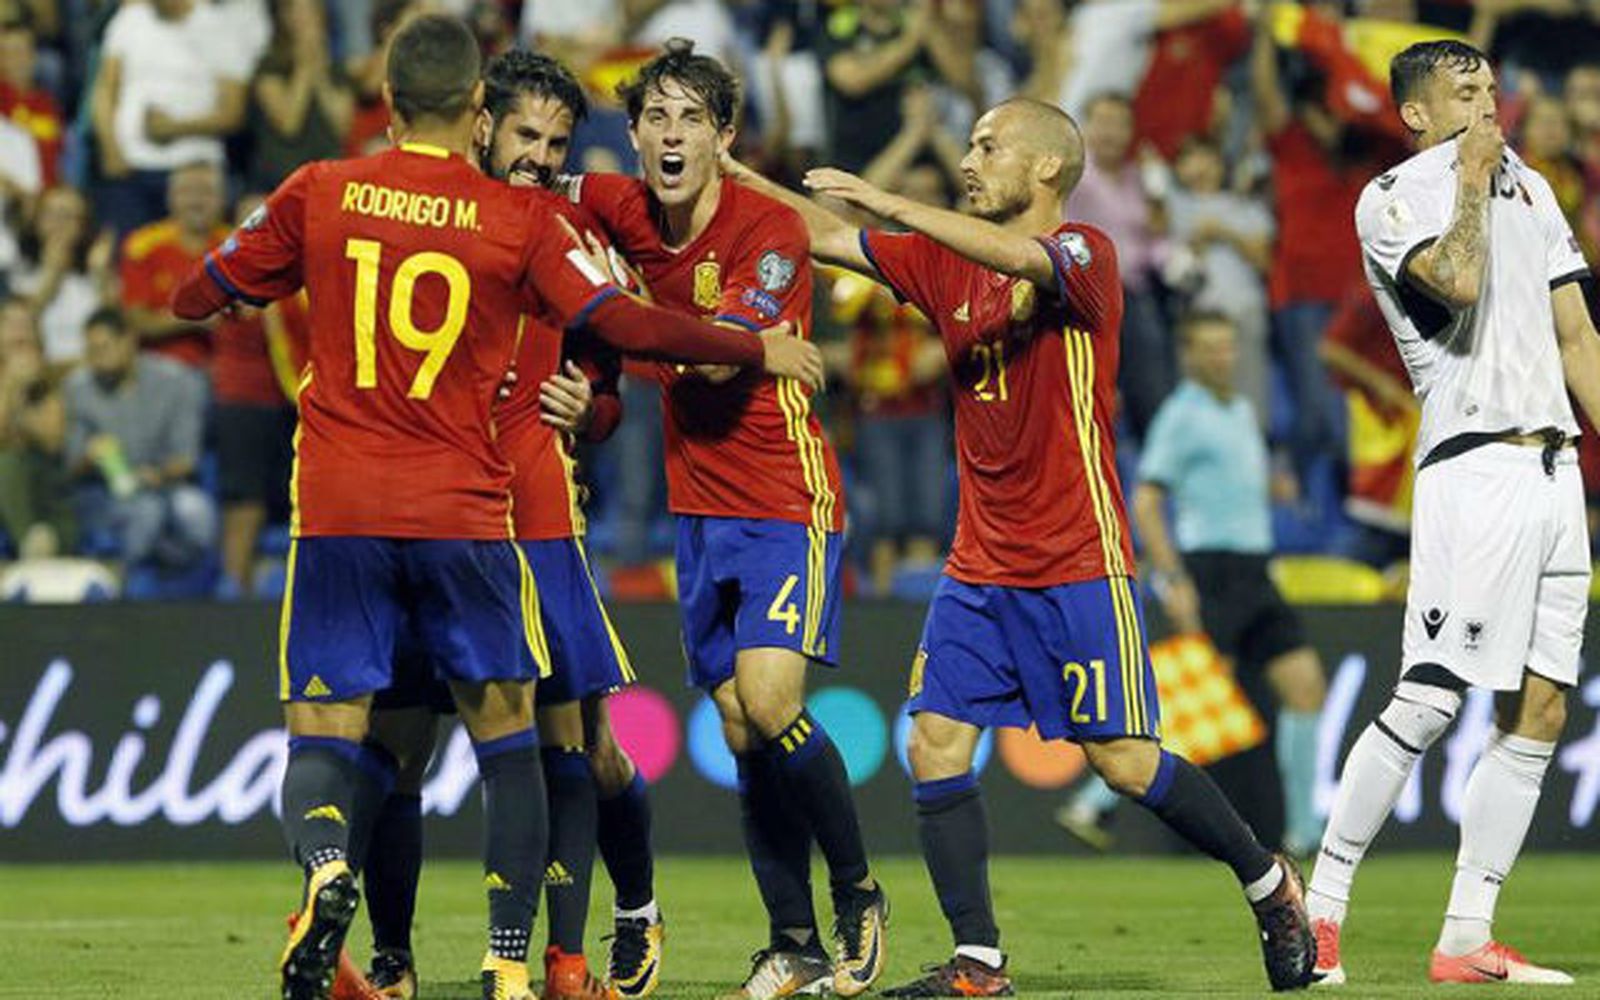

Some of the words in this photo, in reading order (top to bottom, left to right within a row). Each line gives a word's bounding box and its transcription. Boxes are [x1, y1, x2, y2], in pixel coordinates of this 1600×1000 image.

[341, 181, 451, 228] RODRIGO
[454, 199, 482, 231] M.
[345, 238, 471, 399] 19
[972, 340, 1008, 401] 21
[767, 574, 801, 634] 4
[1063, 660, 1106, 724] 21
